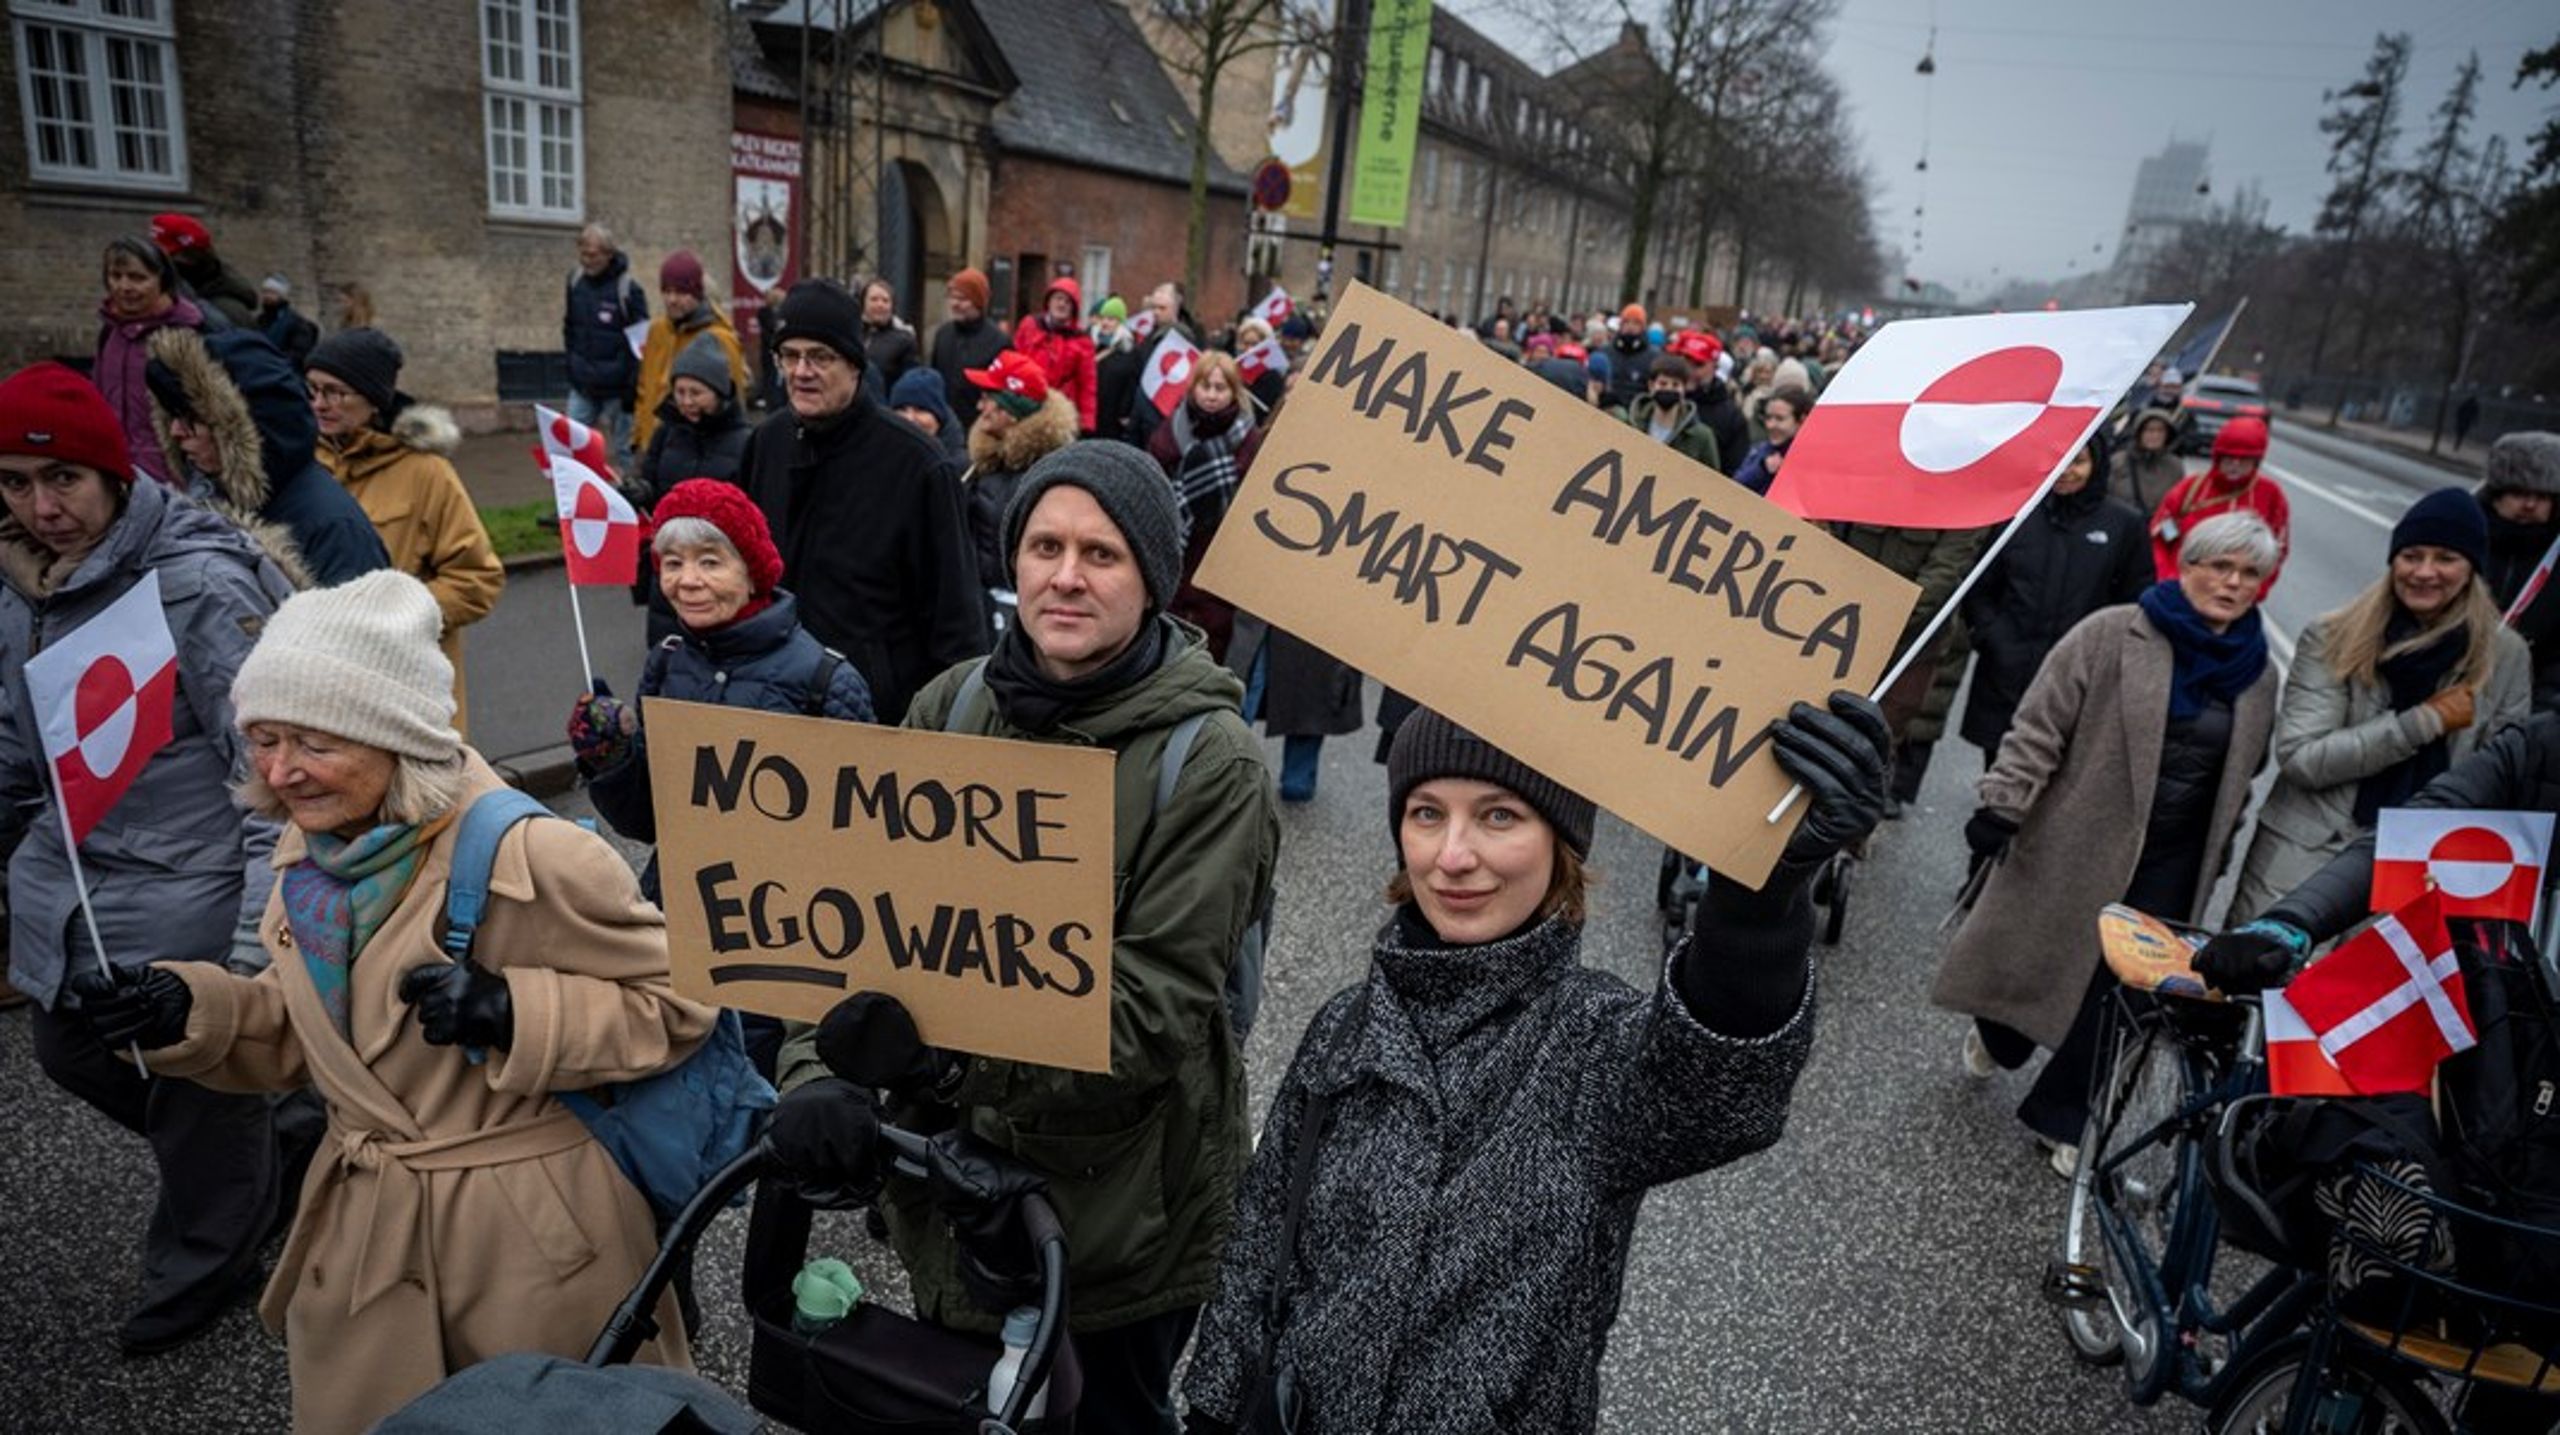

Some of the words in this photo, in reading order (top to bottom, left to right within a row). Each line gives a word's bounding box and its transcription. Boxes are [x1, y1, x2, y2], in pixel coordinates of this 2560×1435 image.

[1309, 323, 1536, 476] MAKE
[1253, 463, 1522, 624] SMART
[691, 739, 809, 821] NO
[833, 766, 1078, 863] MORE
[696, 861, 864, 961] EGO
[874, 892, 1095, 998] WARS
